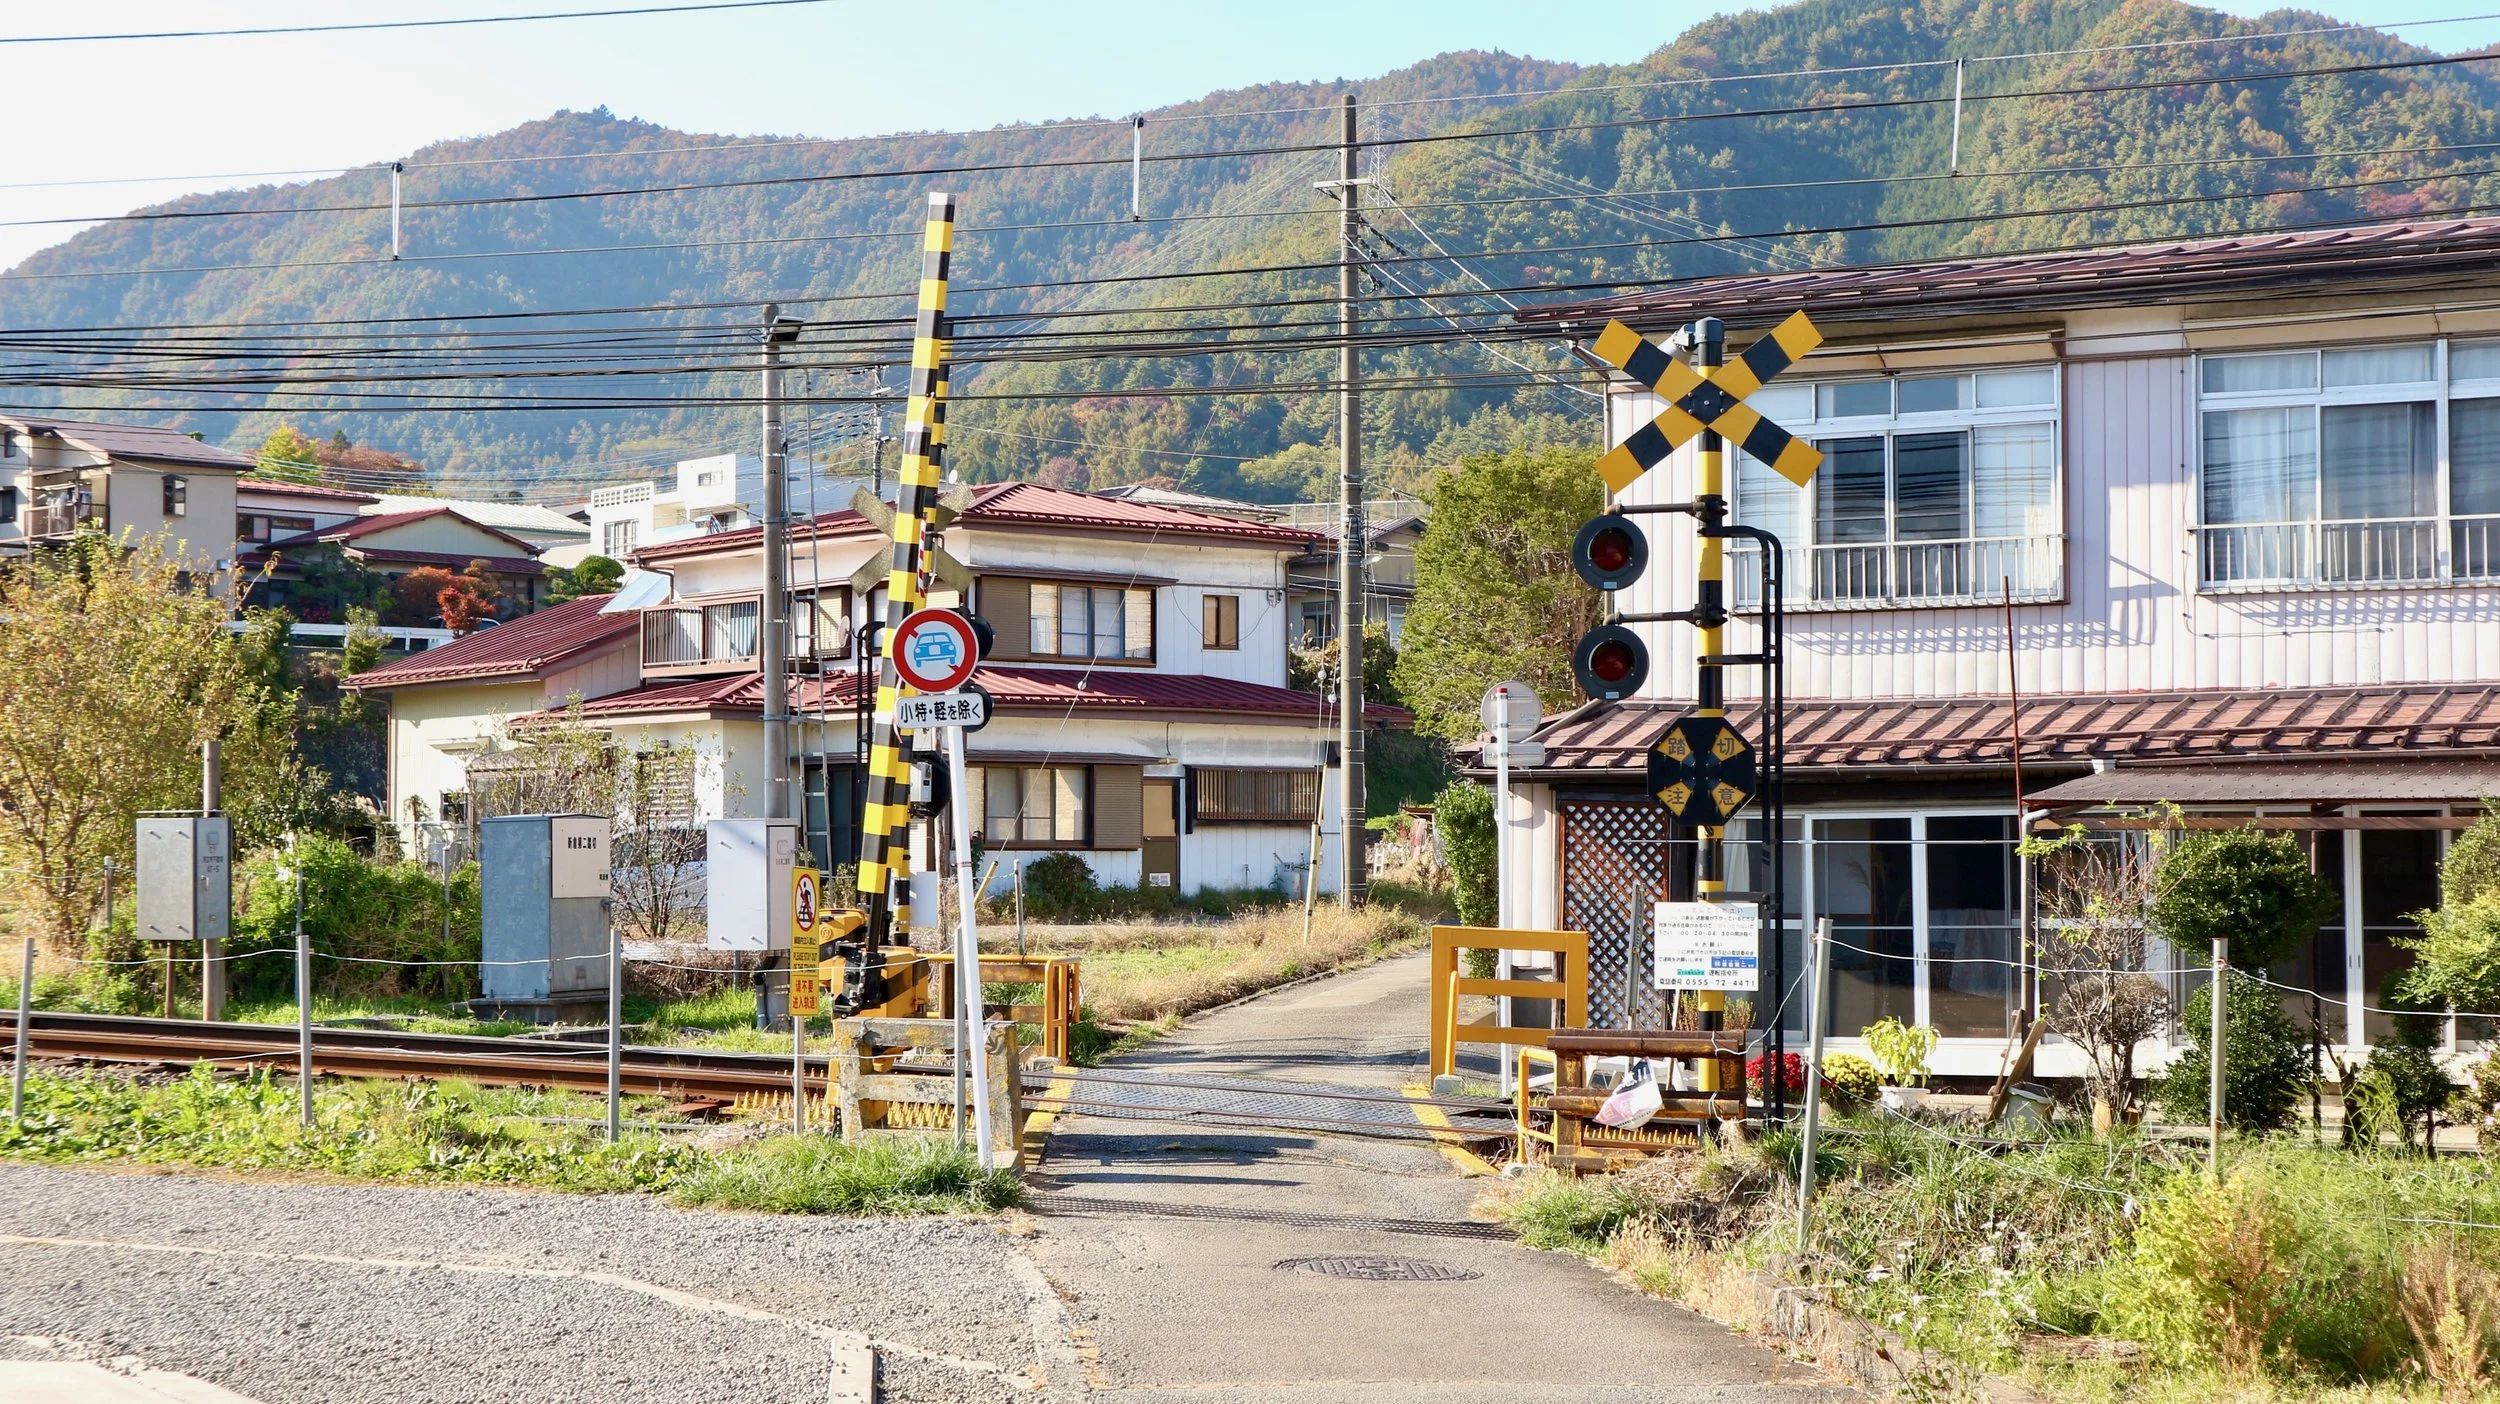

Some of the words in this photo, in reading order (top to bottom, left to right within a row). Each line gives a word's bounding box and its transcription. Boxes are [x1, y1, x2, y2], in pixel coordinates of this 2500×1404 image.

[900, 700, 981, 723] 小特・軽を除く
